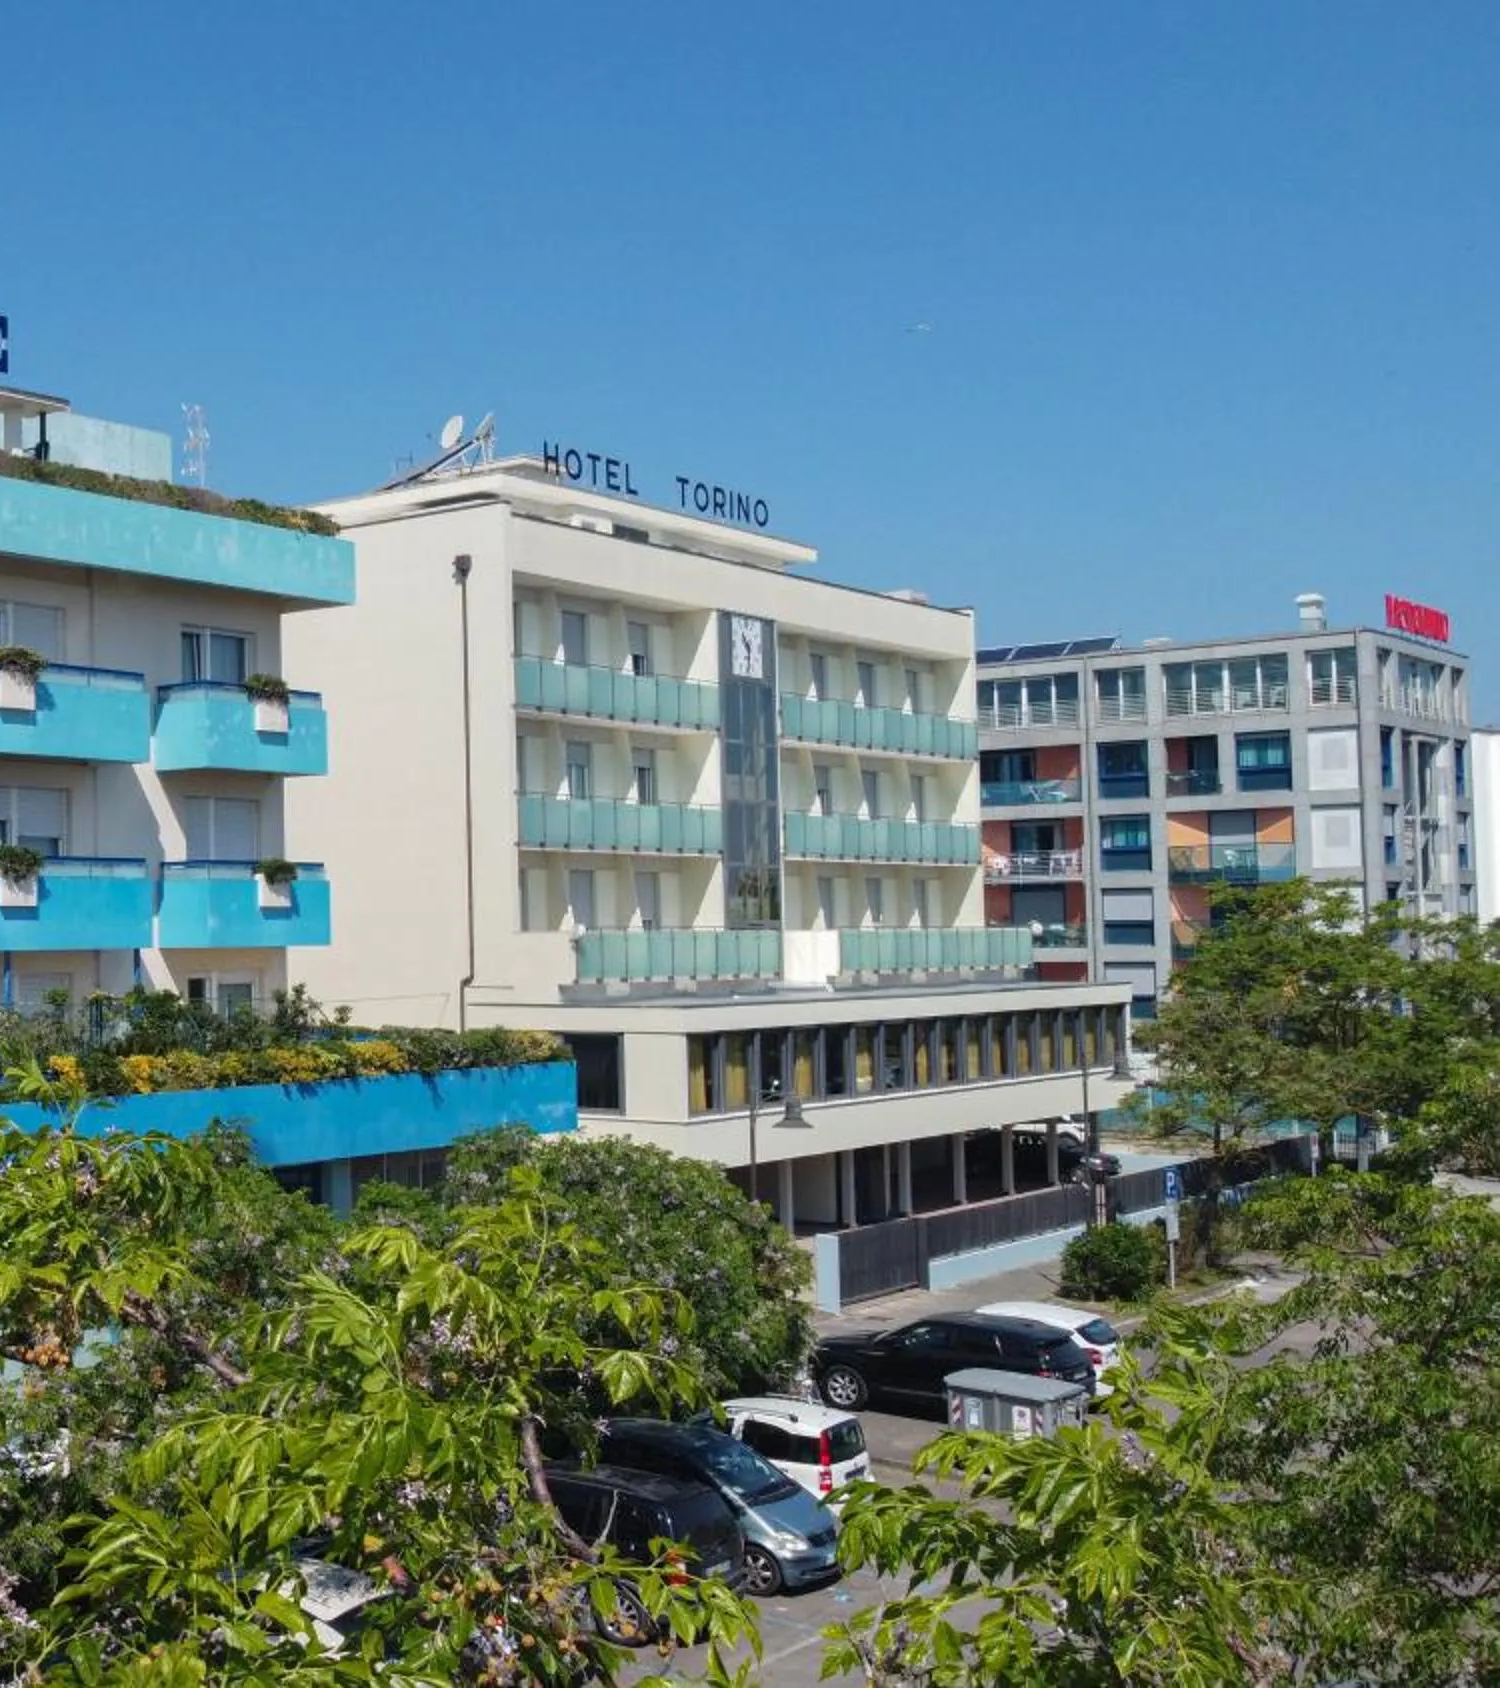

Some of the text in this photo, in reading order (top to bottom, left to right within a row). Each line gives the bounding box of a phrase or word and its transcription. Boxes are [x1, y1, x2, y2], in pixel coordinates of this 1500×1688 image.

[543, 440, 769, 527] HOTEL TORINO
[1165, 1171, 1176, 1196] P
